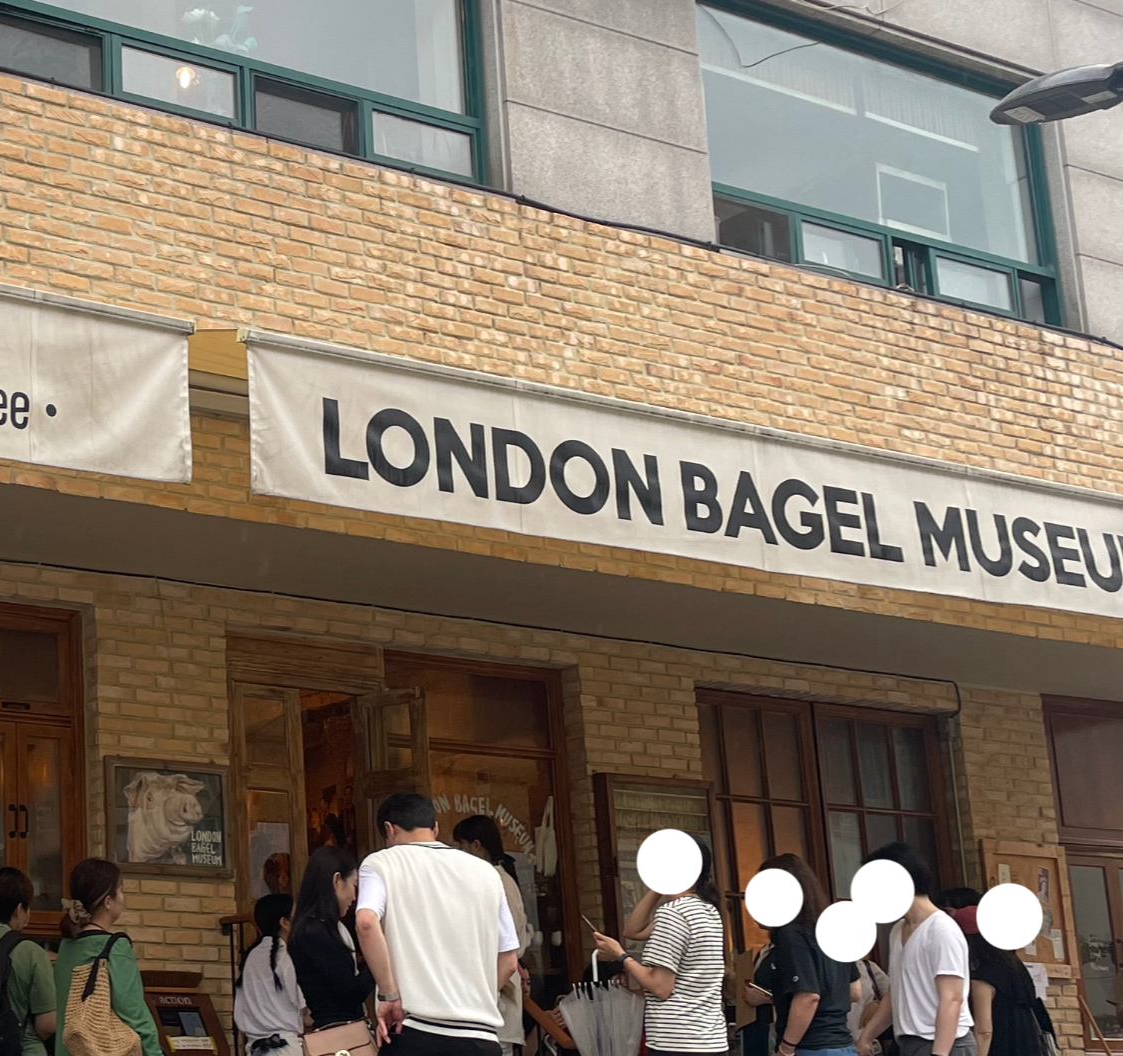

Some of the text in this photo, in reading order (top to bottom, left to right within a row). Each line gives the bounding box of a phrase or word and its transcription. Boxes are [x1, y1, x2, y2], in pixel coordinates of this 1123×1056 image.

[322, 397, 1123, 593] LONDON BAGEL MUSEU
[432, 793, 451, 814] ON
[453, 793, 494, 818] BAGEL
[191, 830, 222, 843] LONDON
[191, 843, 216, 854] BAGEL
[191, 854, 223, 866] MUSEUM
